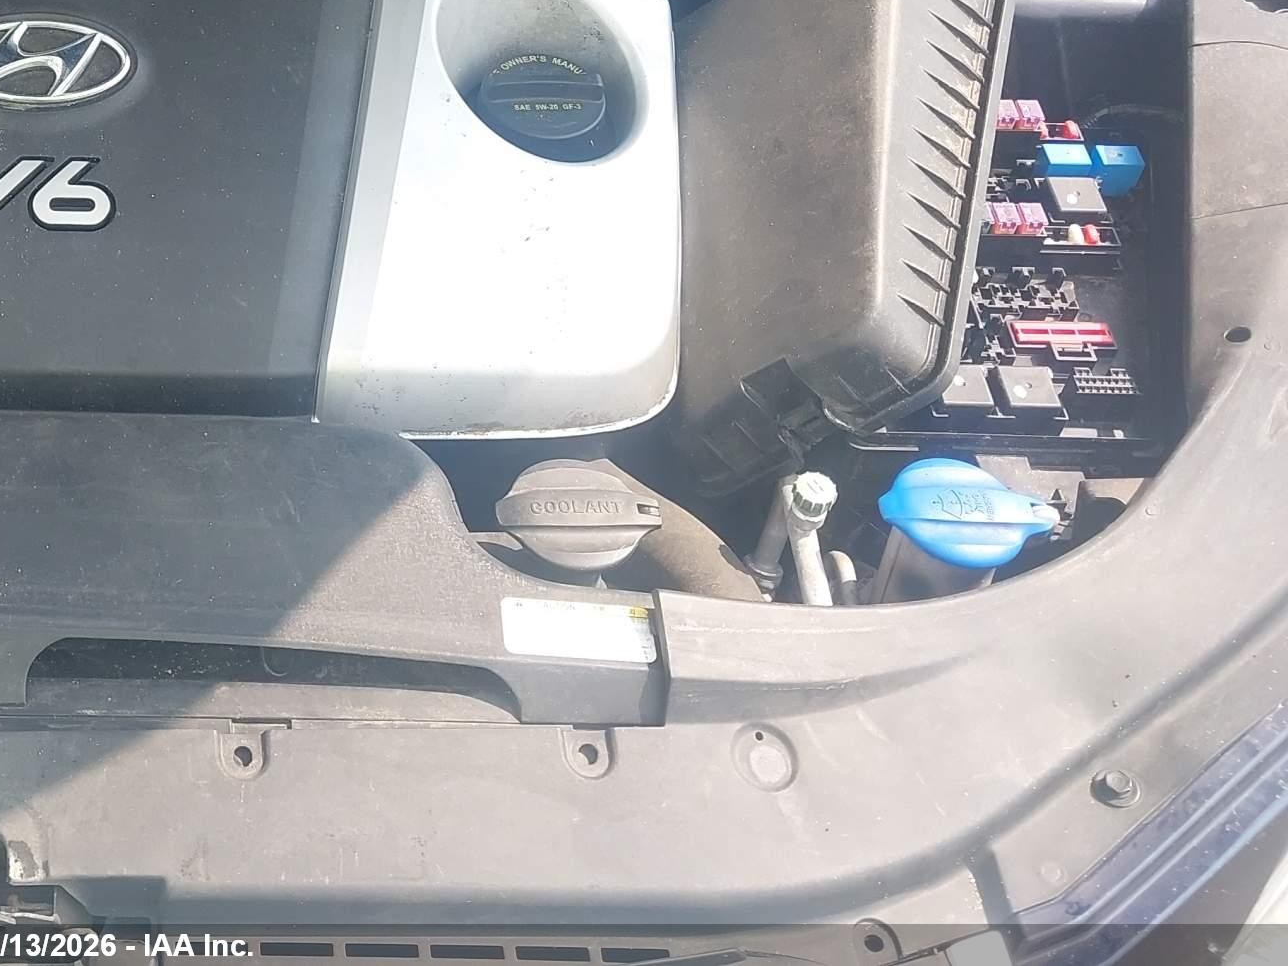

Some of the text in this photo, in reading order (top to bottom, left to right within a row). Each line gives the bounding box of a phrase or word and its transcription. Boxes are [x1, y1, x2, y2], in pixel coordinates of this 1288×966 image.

[500, 54, 587, 75] OWNER'S MANU
[513, 103, 532, 112] SAE
[529, 499, 621, 515] COOLANT
